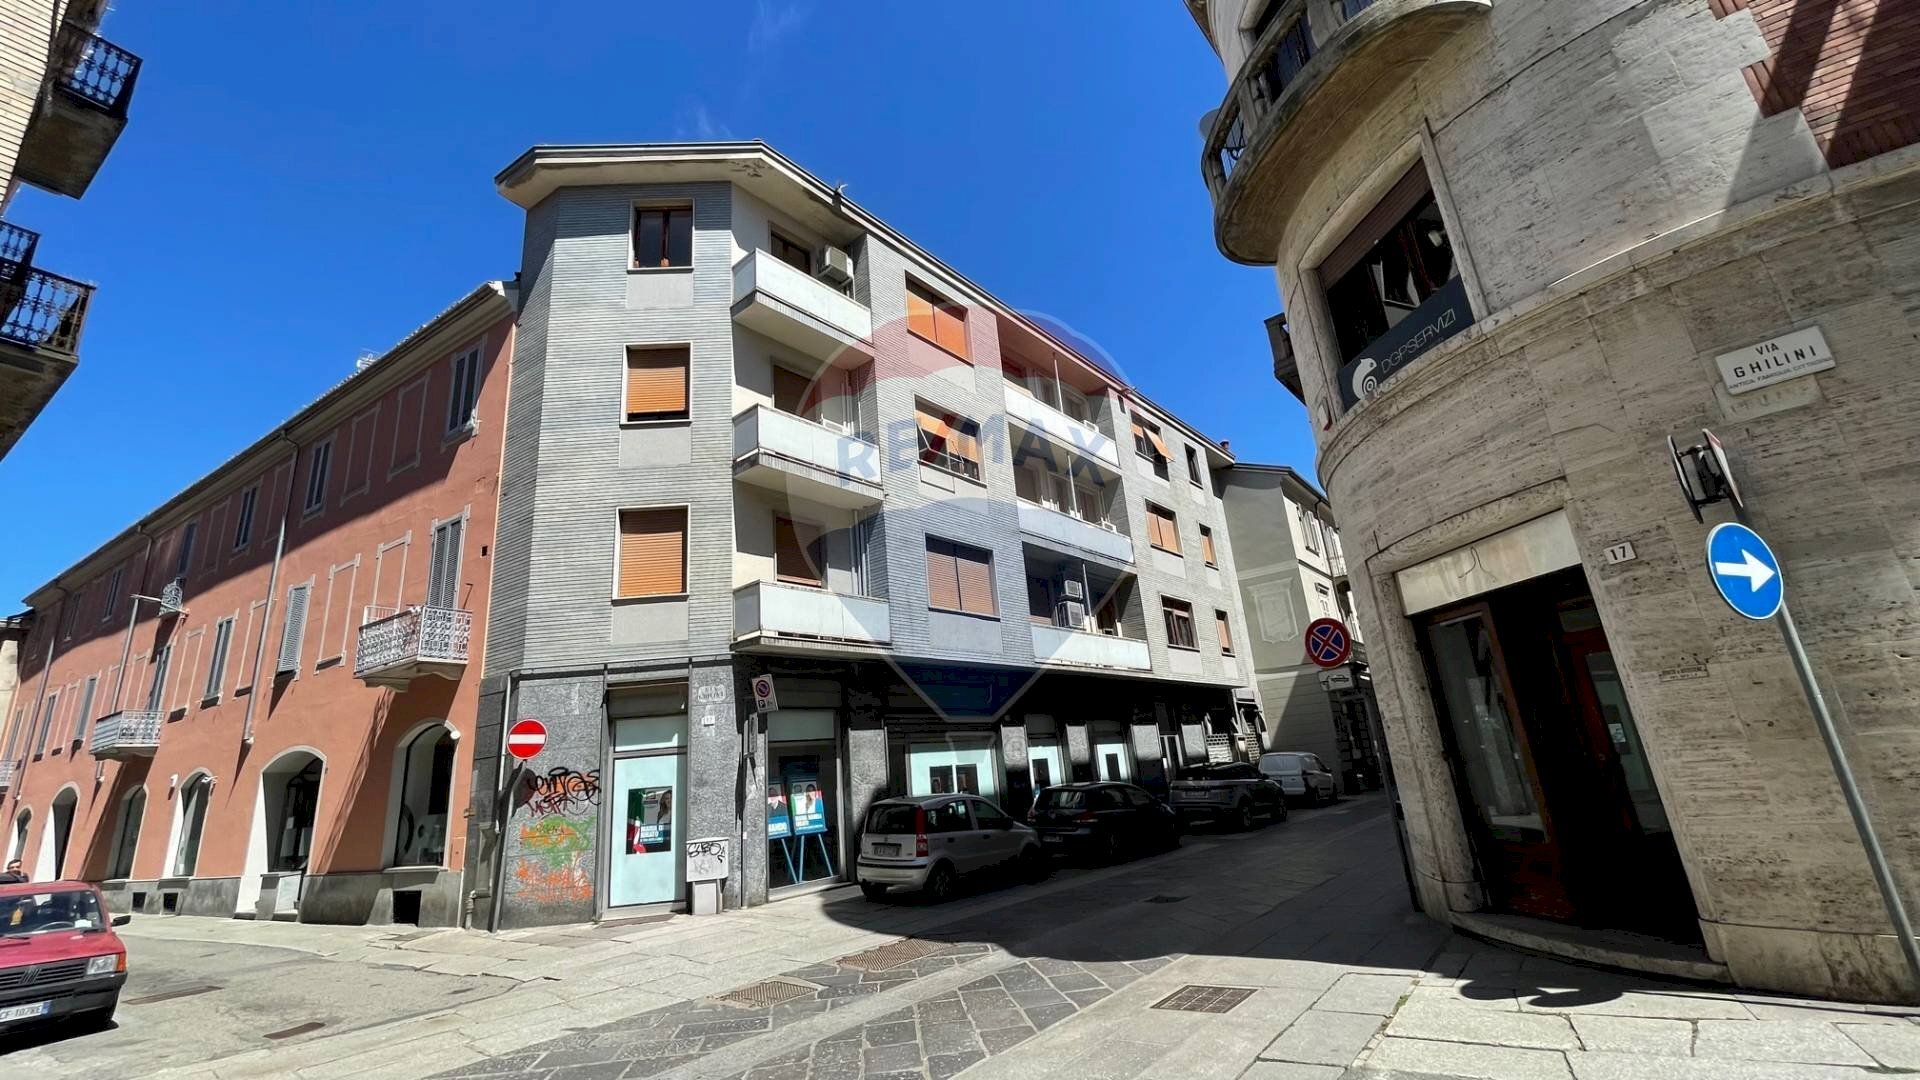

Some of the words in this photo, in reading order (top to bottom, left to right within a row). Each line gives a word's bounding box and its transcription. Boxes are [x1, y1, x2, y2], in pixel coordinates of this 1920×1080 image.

[1755, 342, 1780, 356] VIA
[1733, 345, 1817, 378] GHILINI
[1610, 545, 1627, 561] 17
